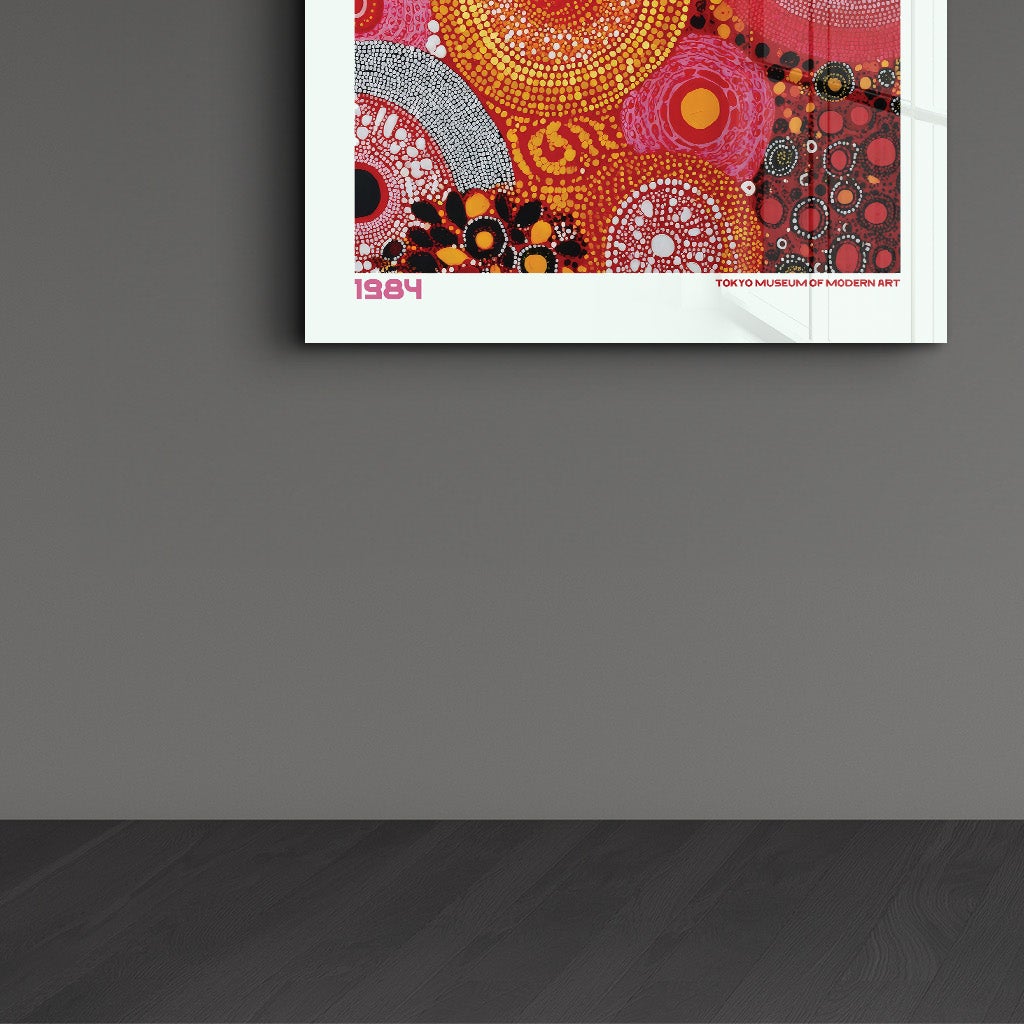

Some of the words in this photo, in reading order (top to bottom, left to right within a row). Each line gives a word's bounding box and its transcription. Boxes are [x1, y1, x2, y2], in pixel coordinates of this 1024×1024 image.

[355, 279, 422, 299] 1984
[715, 279, 753, 288] TOKYO
[755, 279, 807, 288] MUSEUM
[809, 279, 823, 288] OF
[826, 279, 875, 288] MODERN
[877, 279, 900, 288] ART
